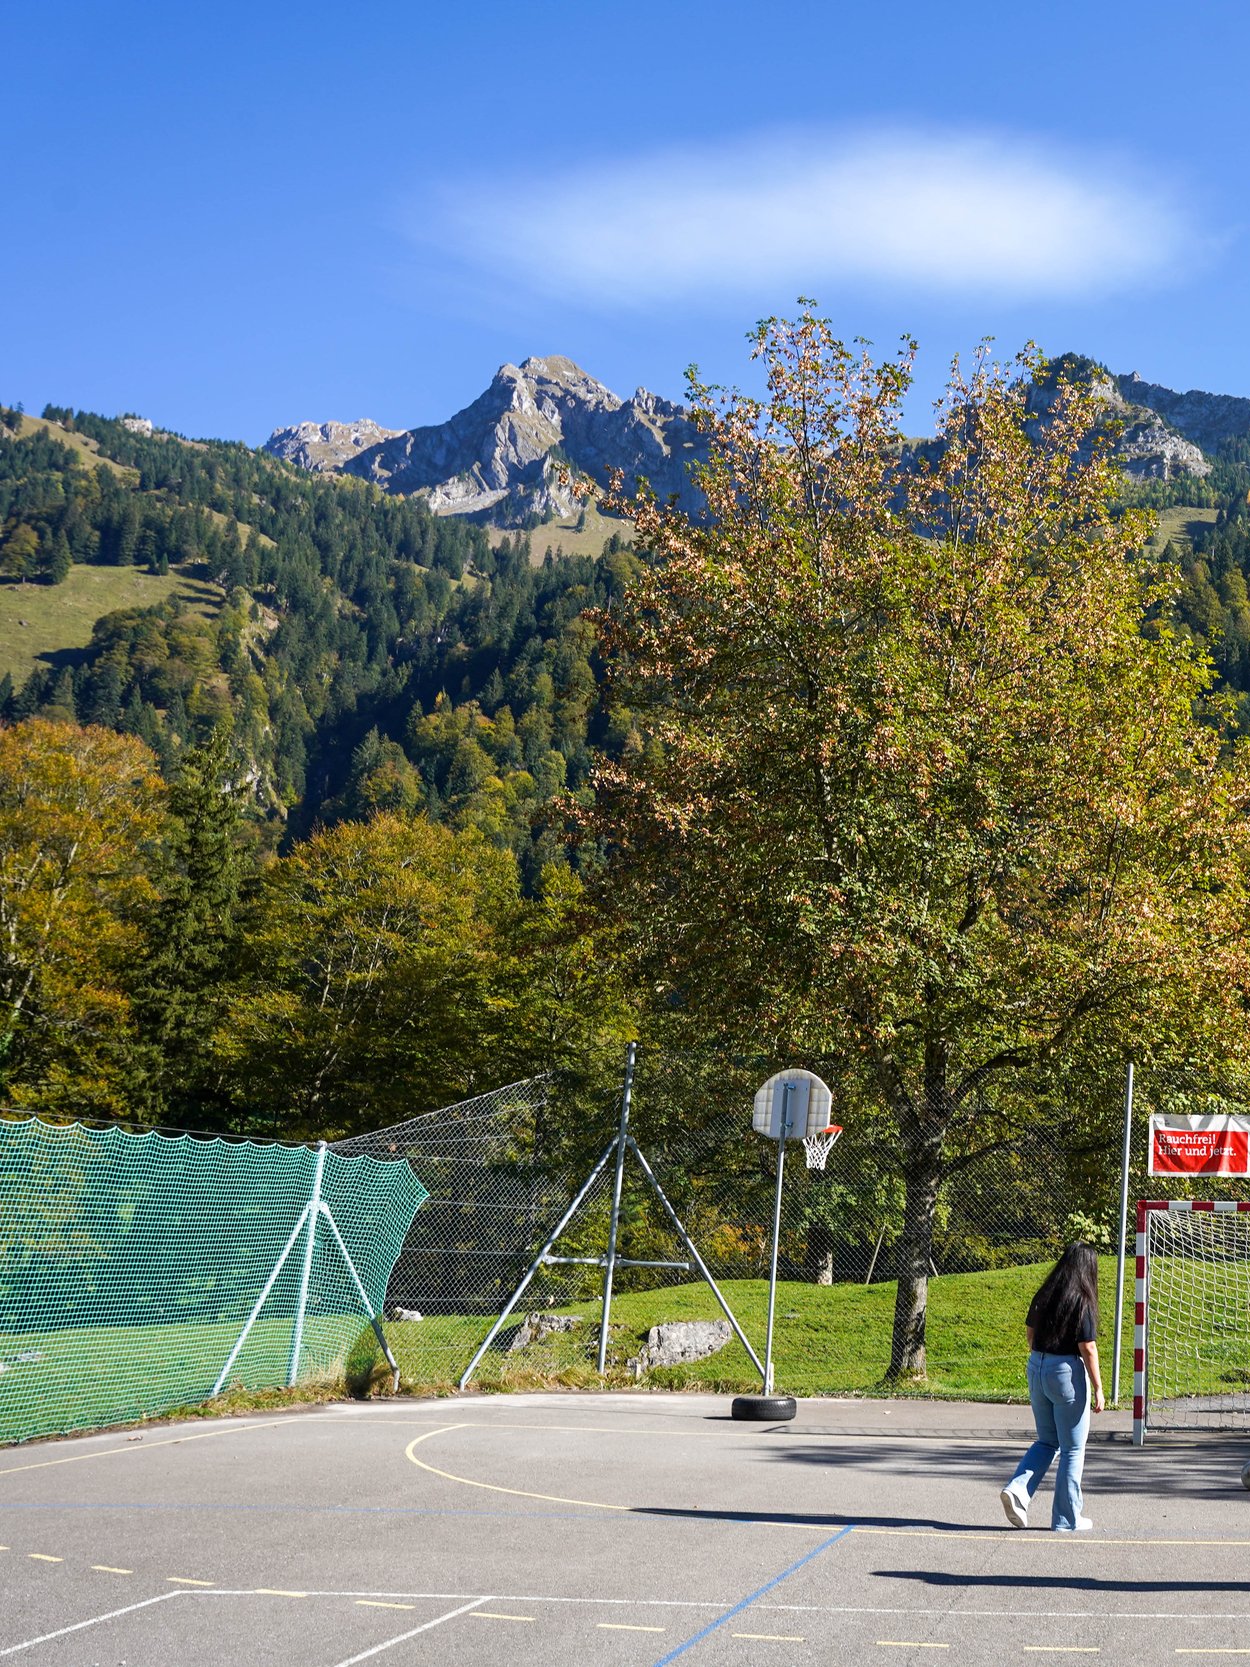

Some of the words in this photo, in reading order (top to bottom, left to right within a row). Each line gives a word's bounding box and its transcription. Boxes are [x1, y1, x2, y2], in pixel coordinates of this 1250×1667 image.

[1159, 1133, 1216, 1145] Rauchfrei!
[1158, 1145, 1182, 1156] Hier
[1185, 1146, 1207, 1156] und
[1209, 1146, 1237, 1158] jetzt.
